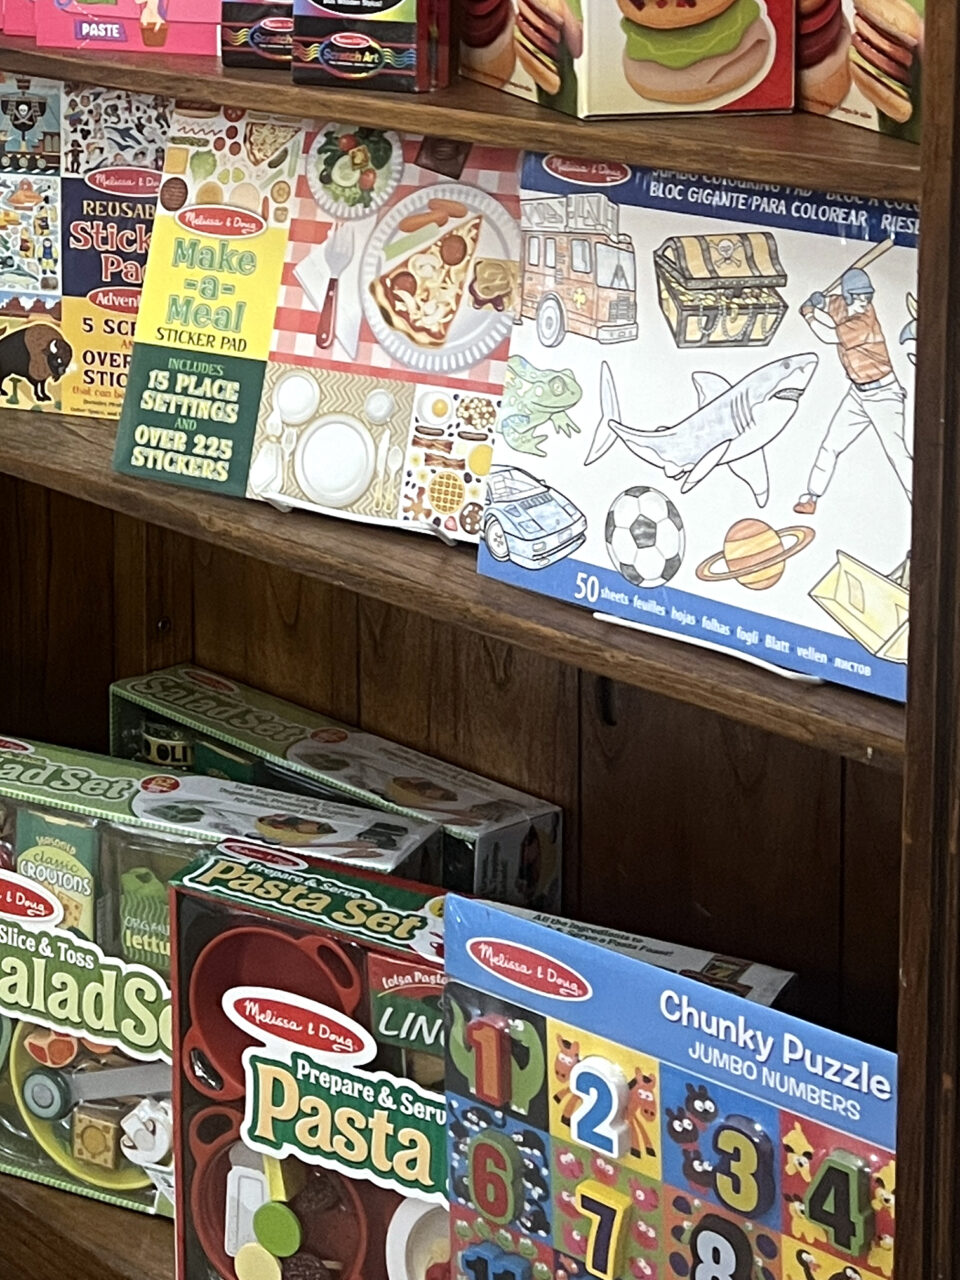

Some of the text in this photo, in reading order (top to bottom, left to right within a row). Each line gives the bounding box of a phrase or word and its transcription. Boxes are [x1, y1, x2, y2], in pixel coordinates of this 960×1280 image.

[81, 23, 120, 38] PASTE
[83, 200, 156, 219] REUSAB
[185, 211, 223, 227] Melissa
[234, 217, 257, 234] Doug
[649, 181, 683, 200] BLOC
[687, 187, 748, 209] GIGANTE
[751, 196, 786, 216] PARA
[791, 201, 869, 227] COLOREAR
[70, 221, 151, 253] Stick
[172, 237, 257, 275] Make
[184, 275, 235, 300] -a-
[166, 295, 247, 333] Meal
[155, 327, 247, 352] STICKER PAD
[148, 369, 240, 400] 15 PLACE
[168, 358, 224, 376] INCLUDES
[140, 390, 239, 424] SETTINGS
[174, 418, 197, 431] AND
[134, 425, 233, 458] OVER 225
[131, 446, 229, 483] STICKERS
[573, 572, 828, 665] 50 sheets feuilles hojas folhas fogli Blatt vellen
[50, 768, 135, 799] Set
[20, 861, 91, 896] CROUTONS
[34, 851, 79, 874] classic
[16, 891, 49, 918] Doug
[196, 860, 422, 938] Pasta Set
[57, 942, 95, 970] Toss
[478, 942, 532, 975] Melissa
[546, 969, 581, 997] Doug
[244, 999, 303, 1031] Melissa
[318, 1023, 355, 1051] Doug
[469, 1024, 502, 1101] 1
[659, 989, 892, 1101] Chunky Puzzle
[298, 1059, 375, 1101] Prepare
[688, 1040, 861, 1121] JUMBO NUMBERS
[253, 1061, 433, 1187] Pasta
[574, 1070, 618, 1156] 2
[472, 1142, 511, 1219] 6
[716, 1129, 759, 1213] 3
[808, 1166, 857, 1251] 4
[581, 1194, 618, 1274] 7
